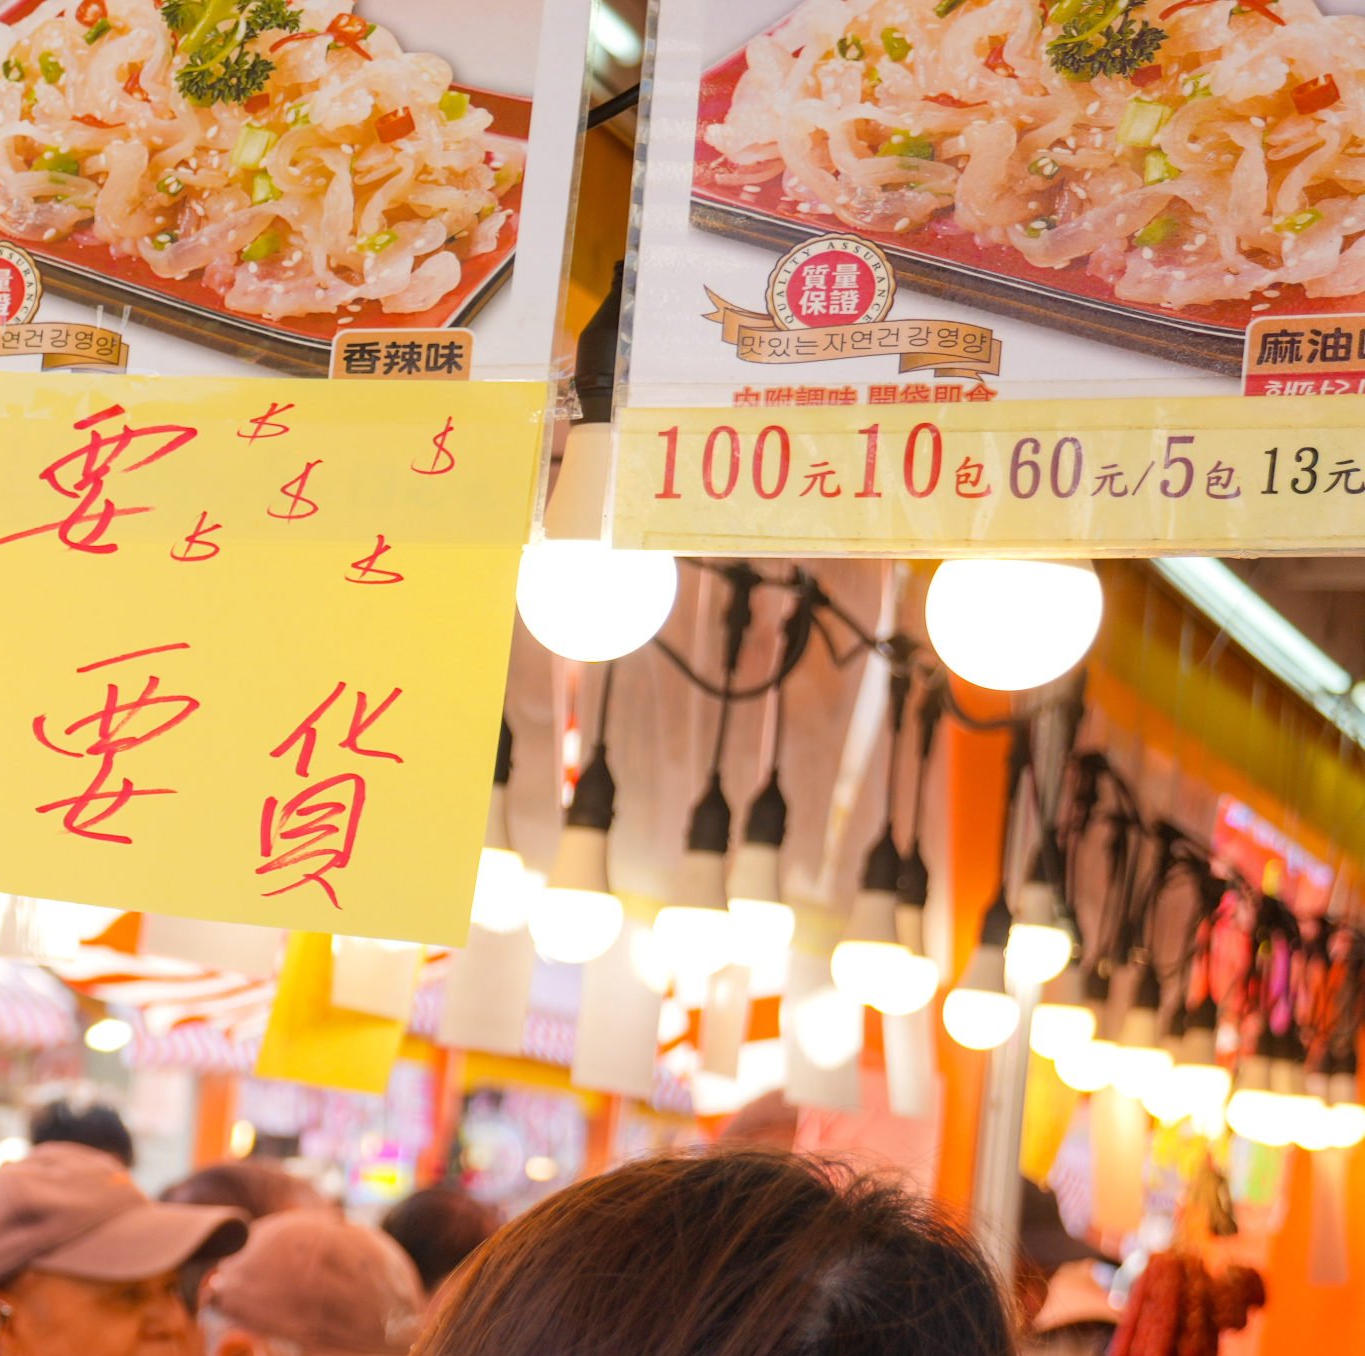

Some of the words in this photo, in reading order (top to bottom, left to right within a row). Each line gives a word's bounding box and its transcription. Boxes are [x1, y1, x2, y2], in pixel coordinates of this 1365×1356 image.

[801, 263, 862, 291] 質量
[799, 288, 861, 317] 保證
[342, 340, 464, 376] 香辣味
[1256, 326, 1365, 366] 麻油
